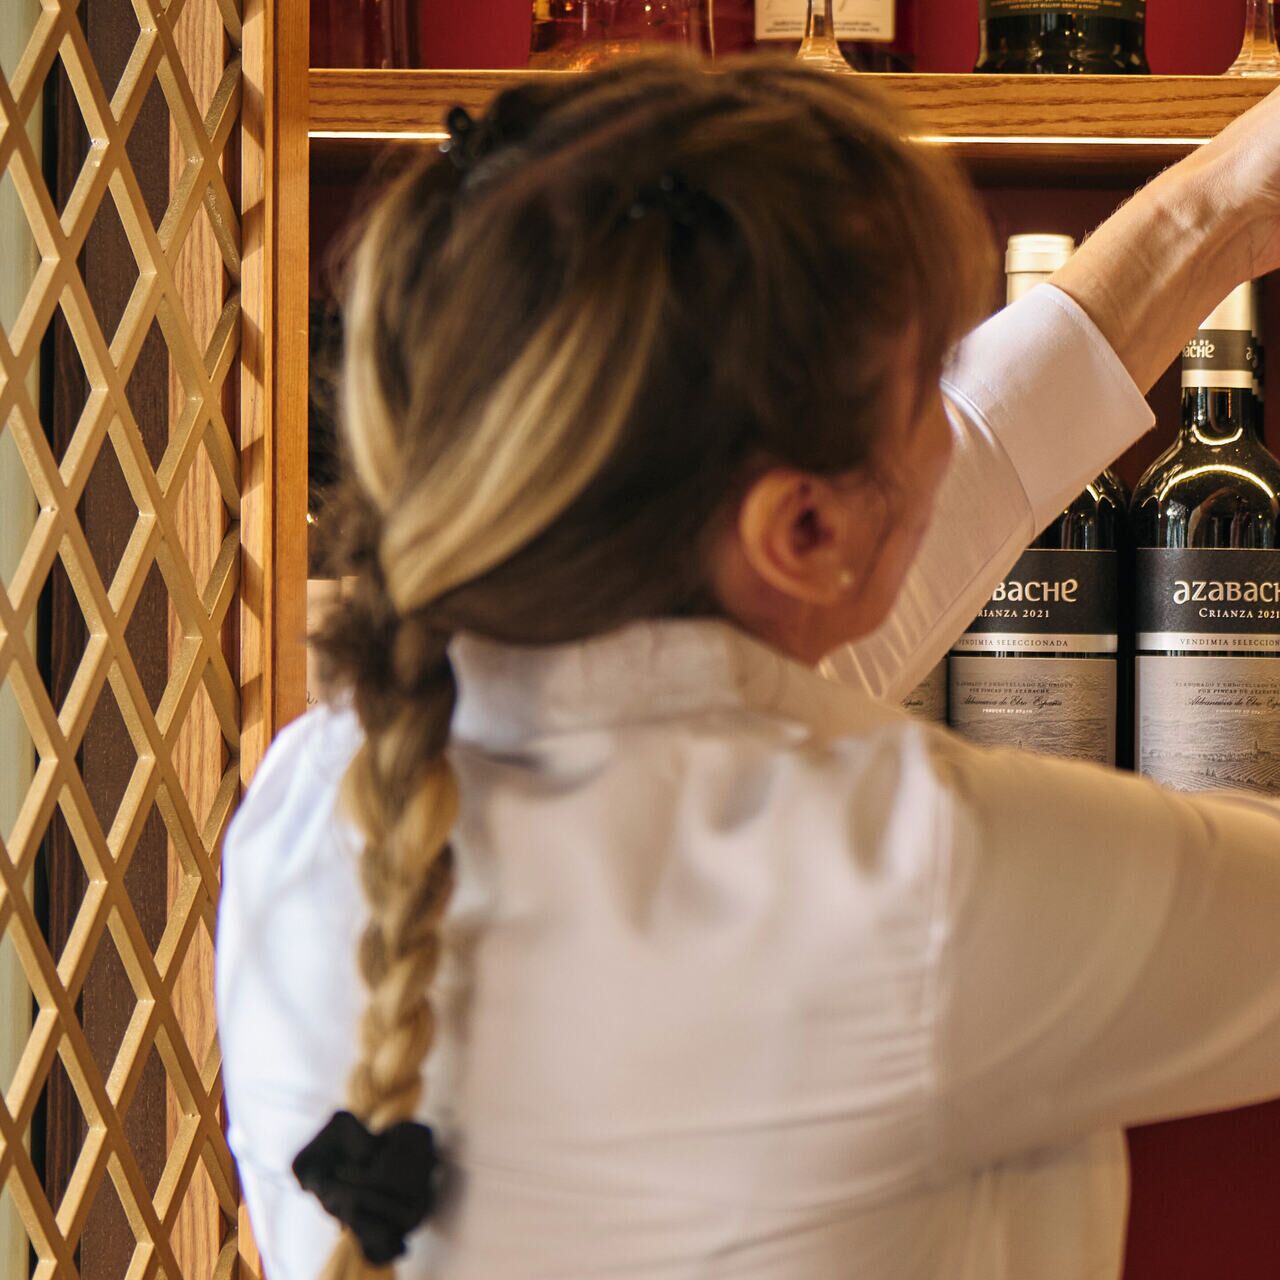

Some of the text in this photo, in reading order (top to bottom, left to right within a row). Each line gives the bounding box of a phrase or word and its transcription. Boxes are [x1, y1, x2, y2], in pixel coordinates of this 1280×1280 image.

[978, 609, 1050, 618] RIANZA 2021
[1257, 610, 1280, 619] 2021
[996, 639, 1069, 647] SELECCIONADA
[1180, 638, 1229, 646] VENDIMIA
